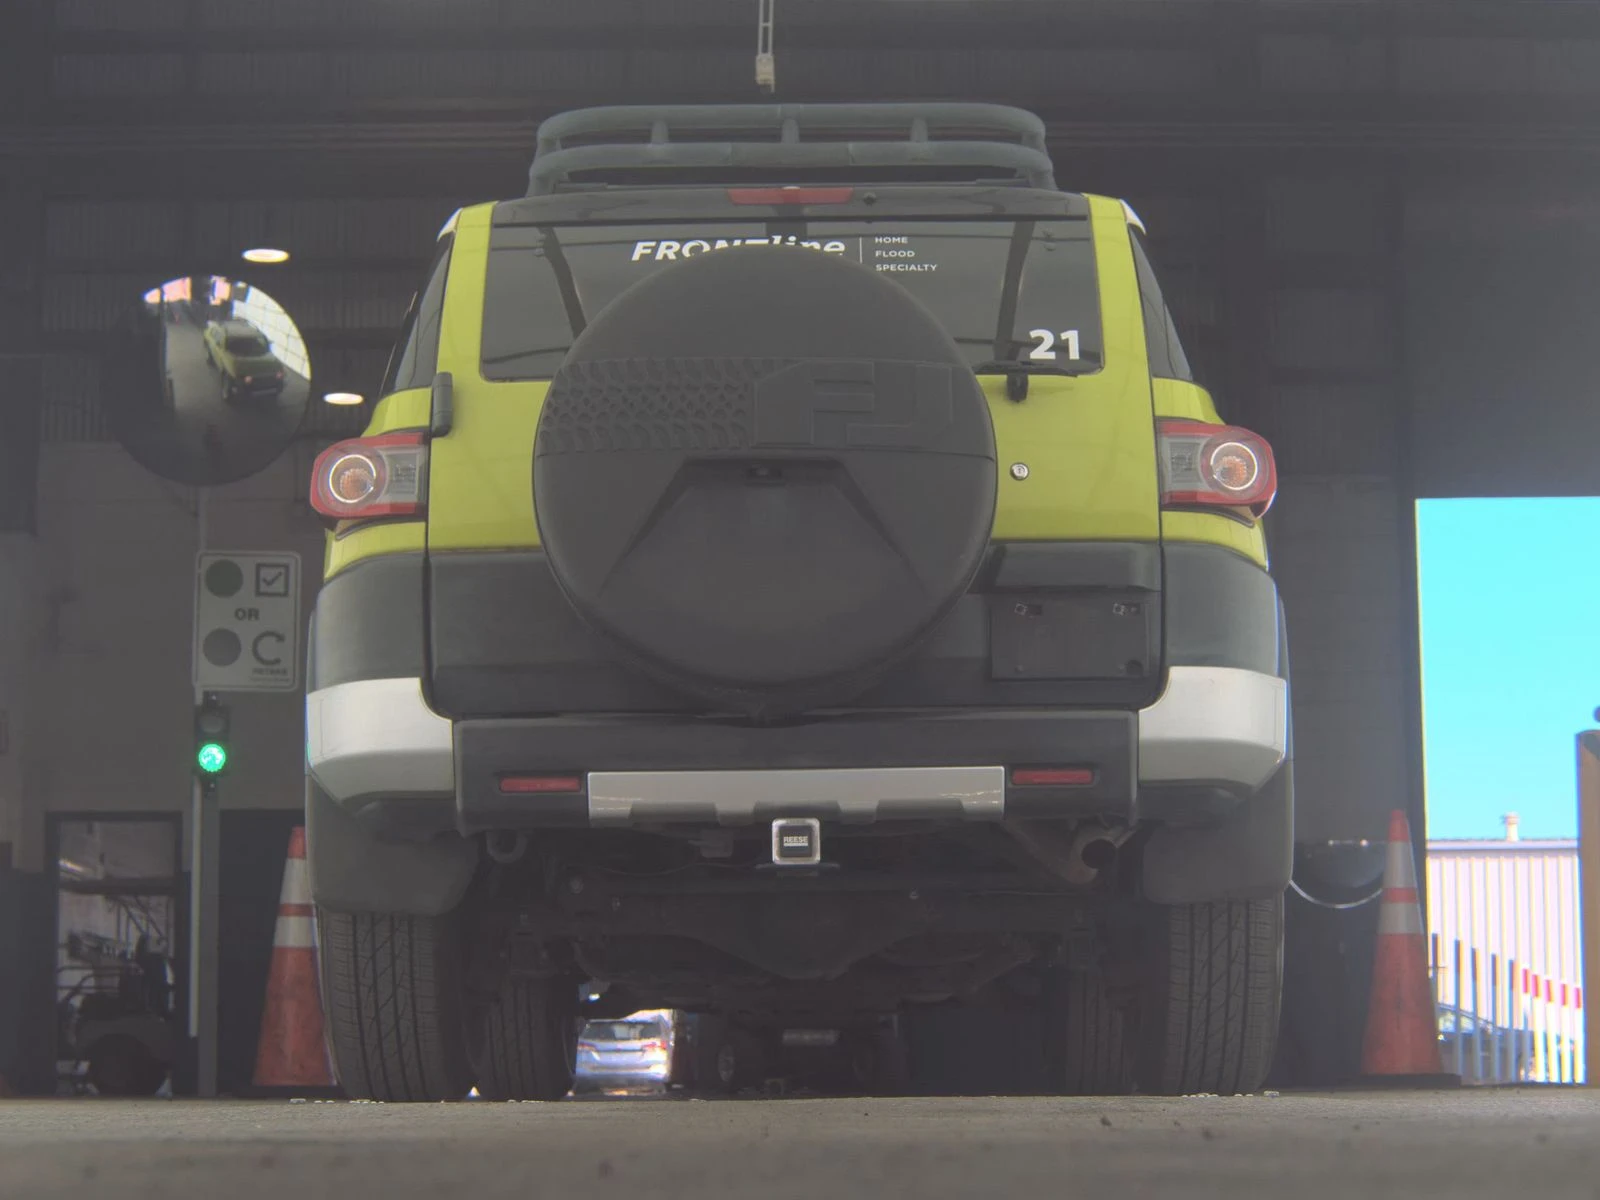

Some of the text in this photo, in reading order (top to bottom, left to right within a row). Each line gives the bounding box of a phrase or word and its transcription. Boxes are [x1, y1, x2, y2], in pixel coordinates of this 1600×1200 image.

[874, 236, 909, 245] HOME
[875, 250, 915, 258] FLOOD
[875, 264, 938, 272] SPECIALTY
[1029, 329, 1080, 360] 21
[234, 607, 260, 621] OR
[783, 836, 809, 844] REESE
